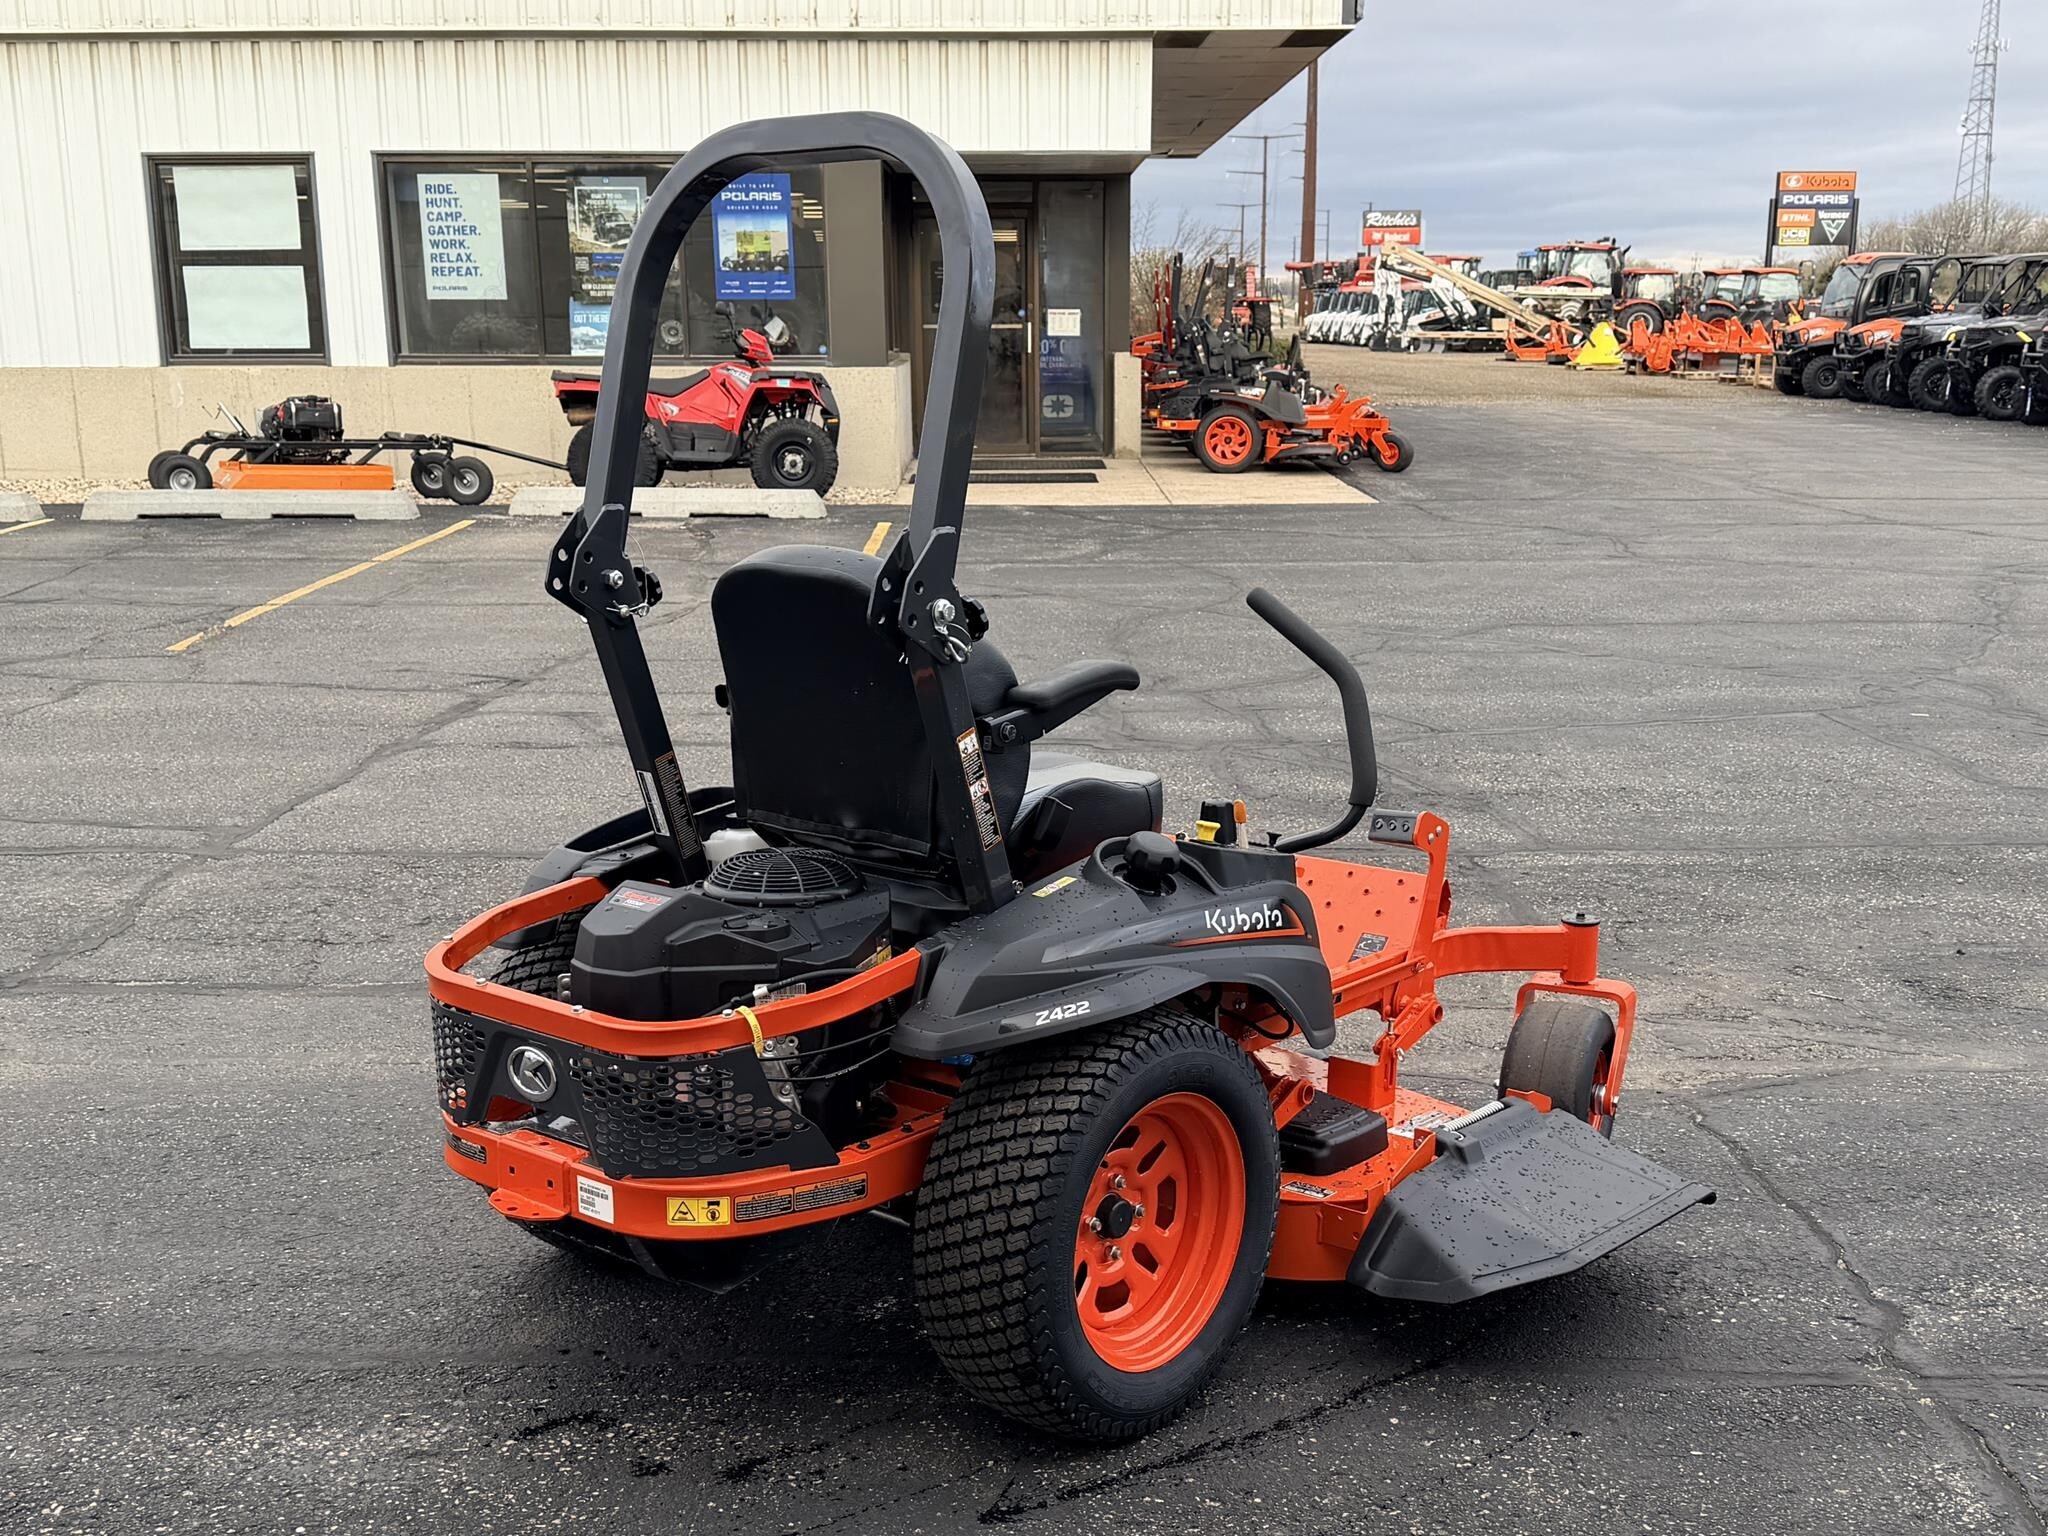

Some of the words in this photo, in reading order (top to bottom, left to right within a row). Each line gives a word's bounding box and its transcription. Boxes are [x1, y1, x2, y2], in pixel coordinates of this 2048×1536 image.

[1806, 175, 1850, 187] Kubota
[424, 184, 457, 195] RIDE.
[720, 191, 783, 201] POLARIS
[1782, 194, 1849, 205] POLARIS
[425, 197, 463, 208] HUNT.
[426, 211, 467, 222] CAMP.
[1365, 211, 1418, 227] Ritchie's
[1781, 213, 1812, 223] STIHL
[427, 225, 482, 236] GATHER.
[1782, 228, 1807, 238] JCB
[428, 239, 471, 250] WORK.
[430, 252, 477, 263] RELAX.
[431, 266, 483, 277] REPEAT.
[1204, 903, 1283, 935] Kubota
[1035, 1001, 1091, 1026] Z422
